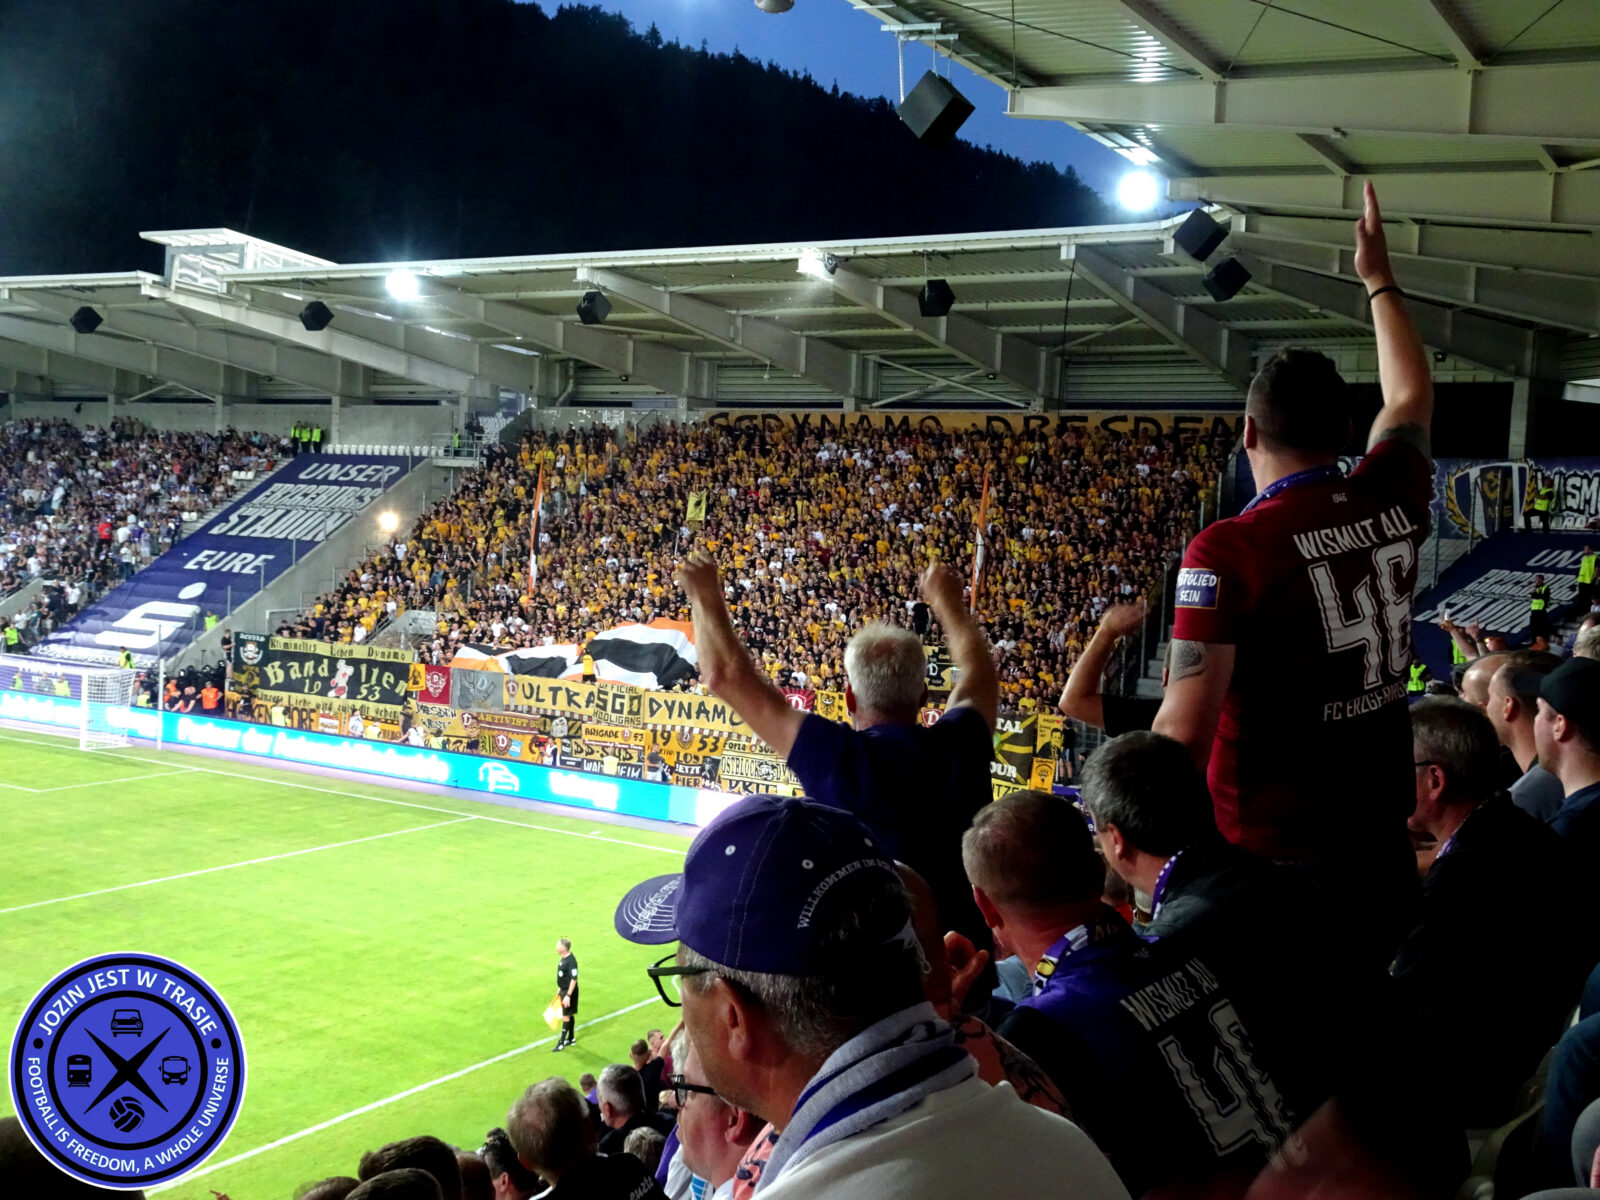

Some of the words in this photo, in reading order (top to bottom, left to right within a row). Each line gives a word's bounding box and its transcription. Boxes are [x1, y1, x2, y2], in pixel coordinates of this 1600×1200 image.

[298, 462, 400, 482] UNSER
[208, 506, 353, 541] STADION
[1293, 518, 1380, 560] WISMUT
[184, 550, 275, 574] EURE
[1180, 590, 1200, 602] SEIN
[1308, 538, 1414, 690] 46
[1324, 702, 1343, 721] FC
[585, 728, 619, 738] BRIGADE
[633, 733, 644, 742] 53
[651, 730, 671, 746] 19
[697, 735, 719, 752] 53
[676, 752, 700, 764] LOS
[675, 776, 701, 788] HIER
[1119, 970, 1201, 1031] WISMUT
